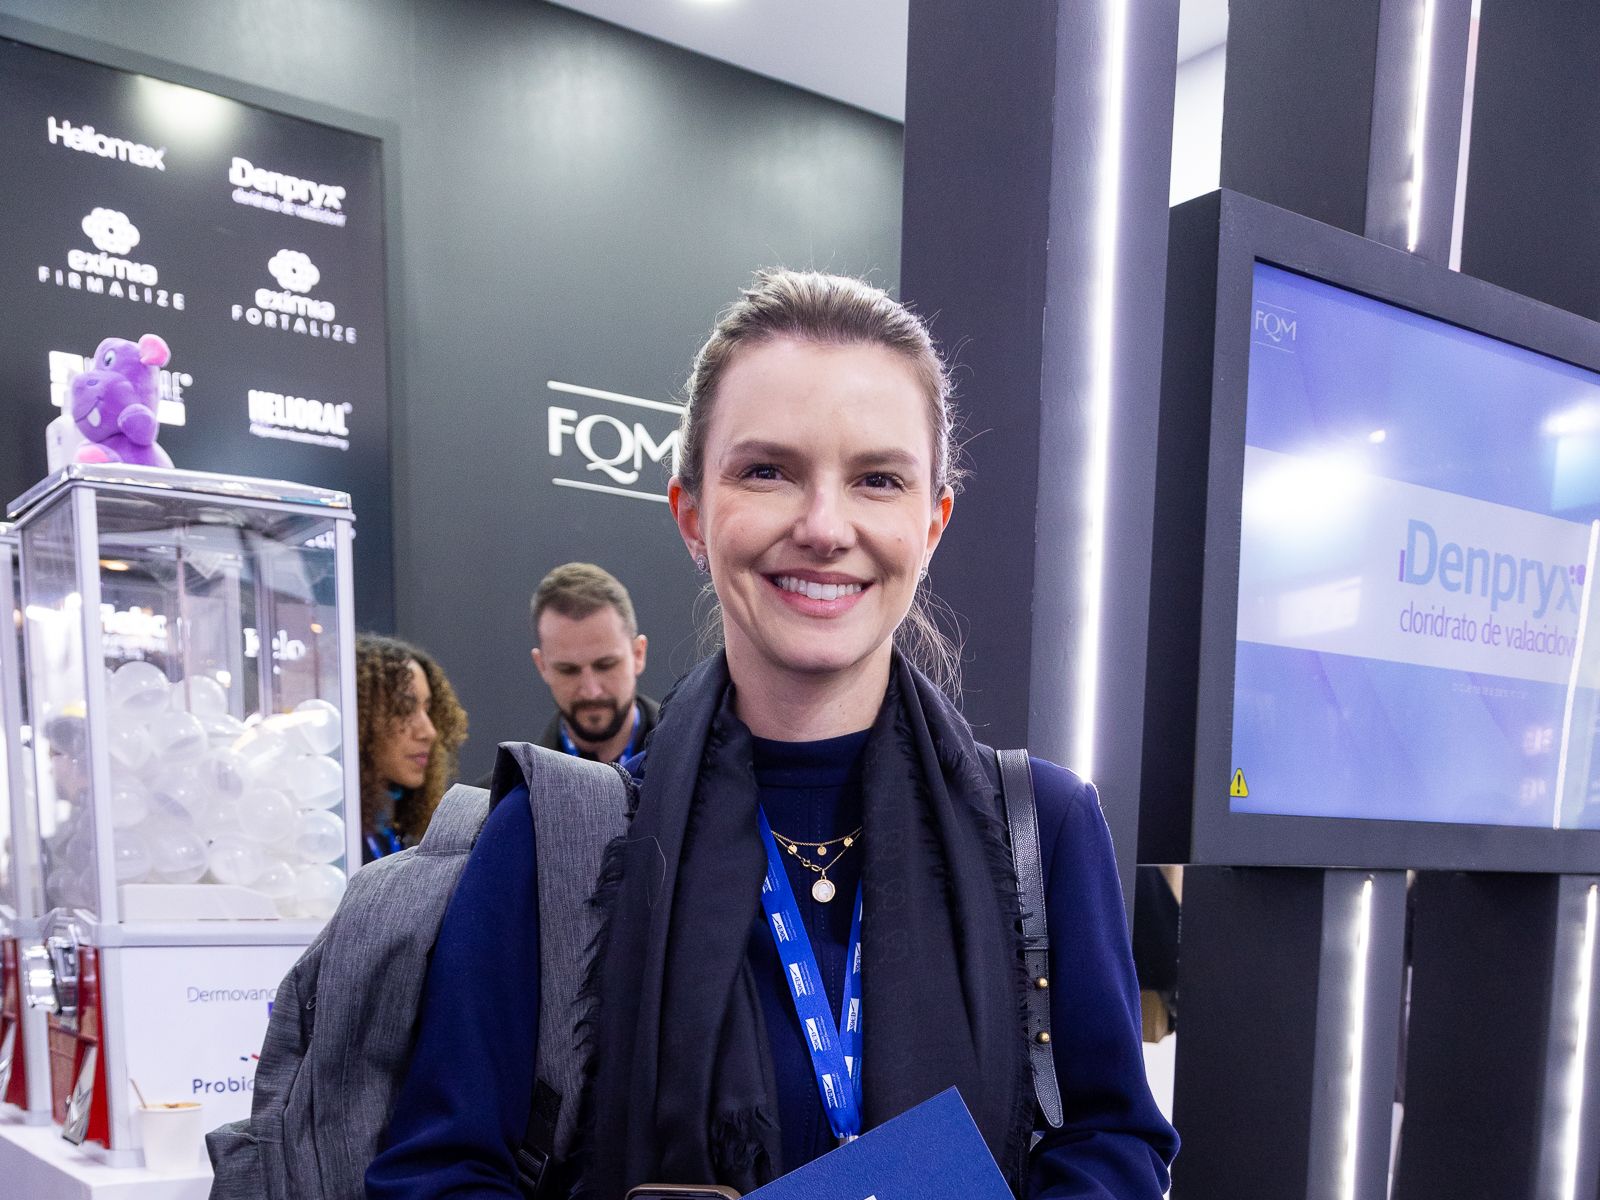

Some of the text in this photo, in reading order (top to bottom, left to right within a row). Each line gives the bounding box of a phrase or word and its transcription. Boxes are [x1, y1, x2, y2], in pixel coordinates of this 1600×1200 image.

[229, 157, 346, 210] Denpryx
[38, 266, 185, 311] FIRMALIZE
[231, 304, 357, 345] FORTALIZE
[1255, 309, 1297, 342] FQM
[548, 406, 684, 485] FQM
[1404, 519, 1578, 619] Denpryx
[1400, 601, 1577, 657] cloridrato de valaciclovi
[187, 987, 279, 1002] Dermovanc
